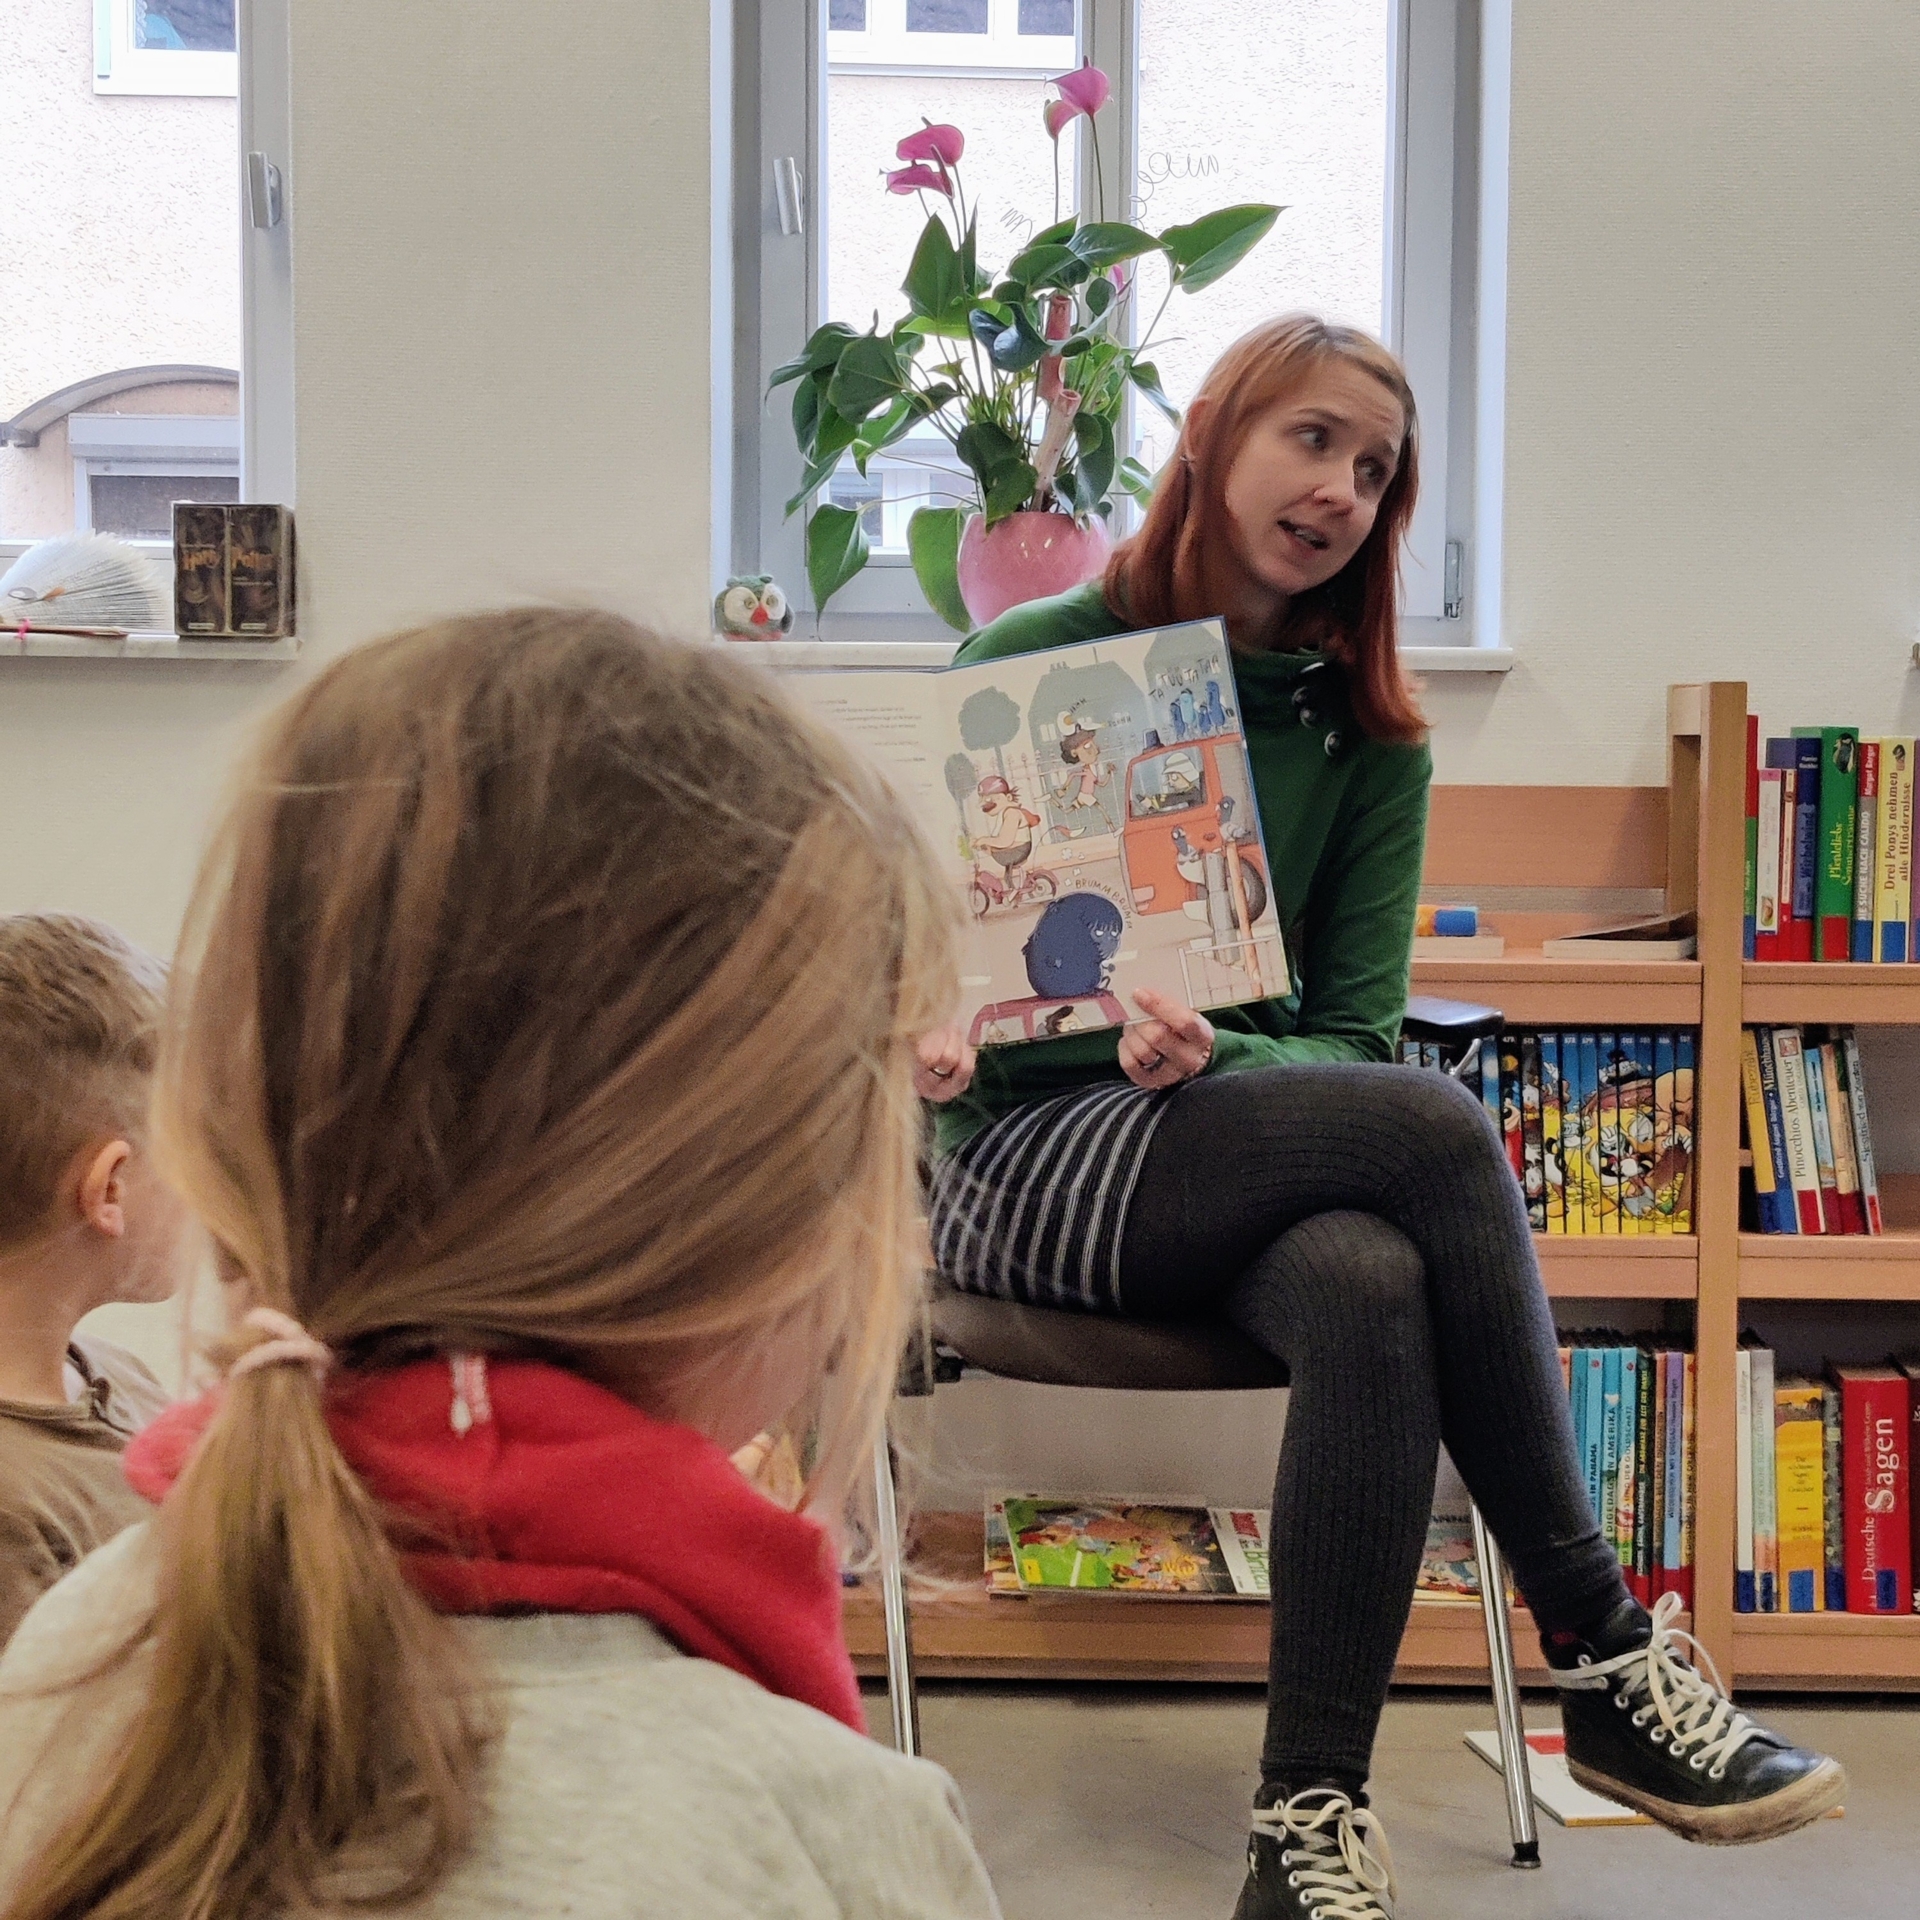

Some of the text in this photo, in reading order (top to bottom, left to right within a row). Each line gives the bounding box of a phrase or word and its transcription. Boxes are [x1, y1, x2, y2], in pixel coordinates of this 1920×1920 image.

[1864, 745, 1876, 796] Margot Berger
[1797, 810, 1815, 879] Wirbelwind
[1859, 810, 1870, 846] CALIDO
[1884, 771, 1899, 890] Drei Ponys nehmen
[1898, 782, 1911, 882] alle Hindernisse
[1075, 878, 1112, 895] BRUMM
[1858, 847, 1869, 875] NACH
[1857, 876, 1869, 906] SUCHE
[1760, 1027, 1777, 1092] Münchhausen
[1851, 1060, 1864, 1094] Xanten
[1770, 1123, 1783, 1147] August
[1782, 1059, 1806, 1178] Pinocchios Abenteuer
[1855, 1111, 1872, 1162] Siegfried
[1606, 1407, 1617, 1459] AMERIKA
[1624, 1406, 1633, 1463] GOLDSCHATZ
[1589, 1443, 1598, 1482] PANAMA
[1864, 1418, 1899, 1511] Sagen
[1589, 1483, 1598, 1495] IN
[1605, 1476, 1615, 1533] DIGEDAGS
[1861, 1516, 1876, 1581] Deutsche
